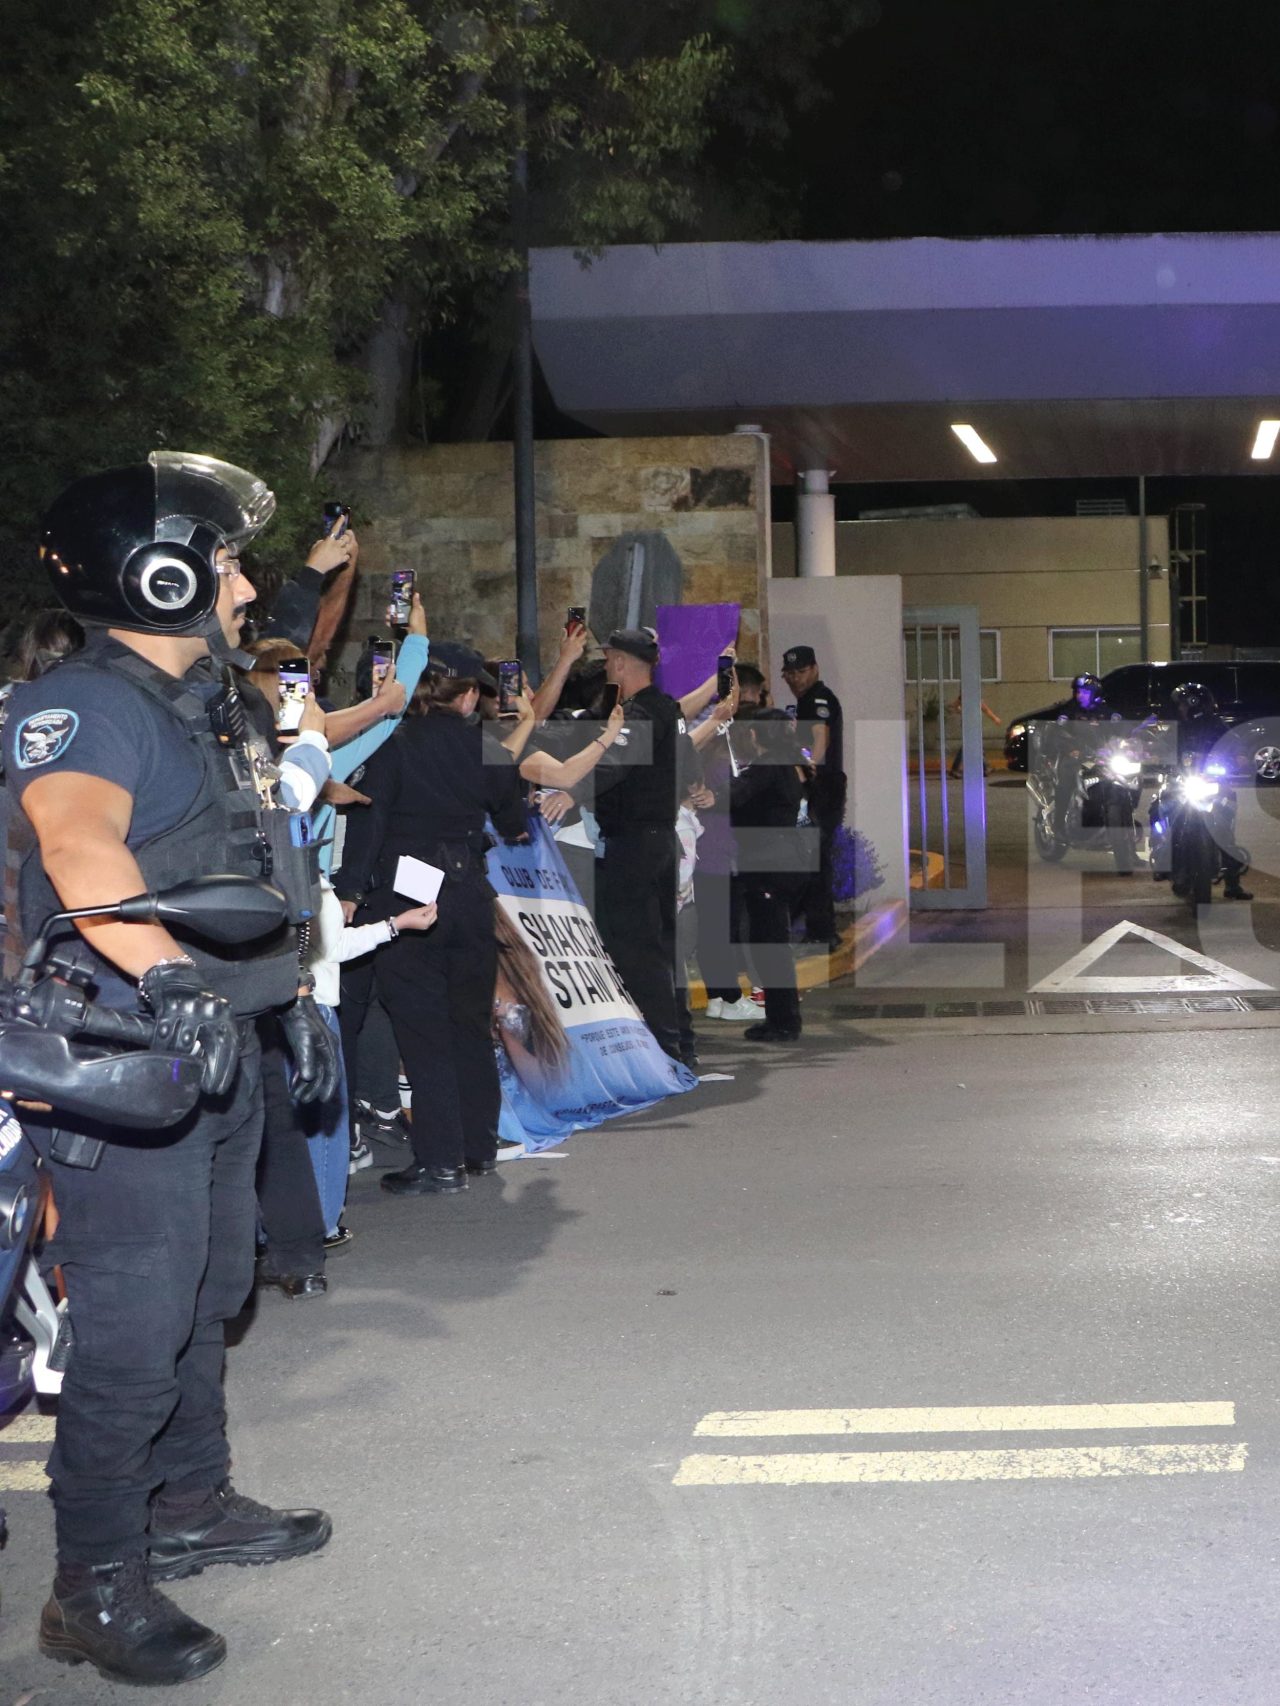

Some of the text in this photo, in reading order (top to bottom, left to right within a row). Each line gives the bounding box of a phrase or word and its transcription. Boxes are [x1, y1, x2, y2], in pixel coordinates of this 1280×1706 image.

[501, 865, 535, 889] CLUB
[535, 869, 555, 890] DE
[544, 961, 615, 1009] STAN
